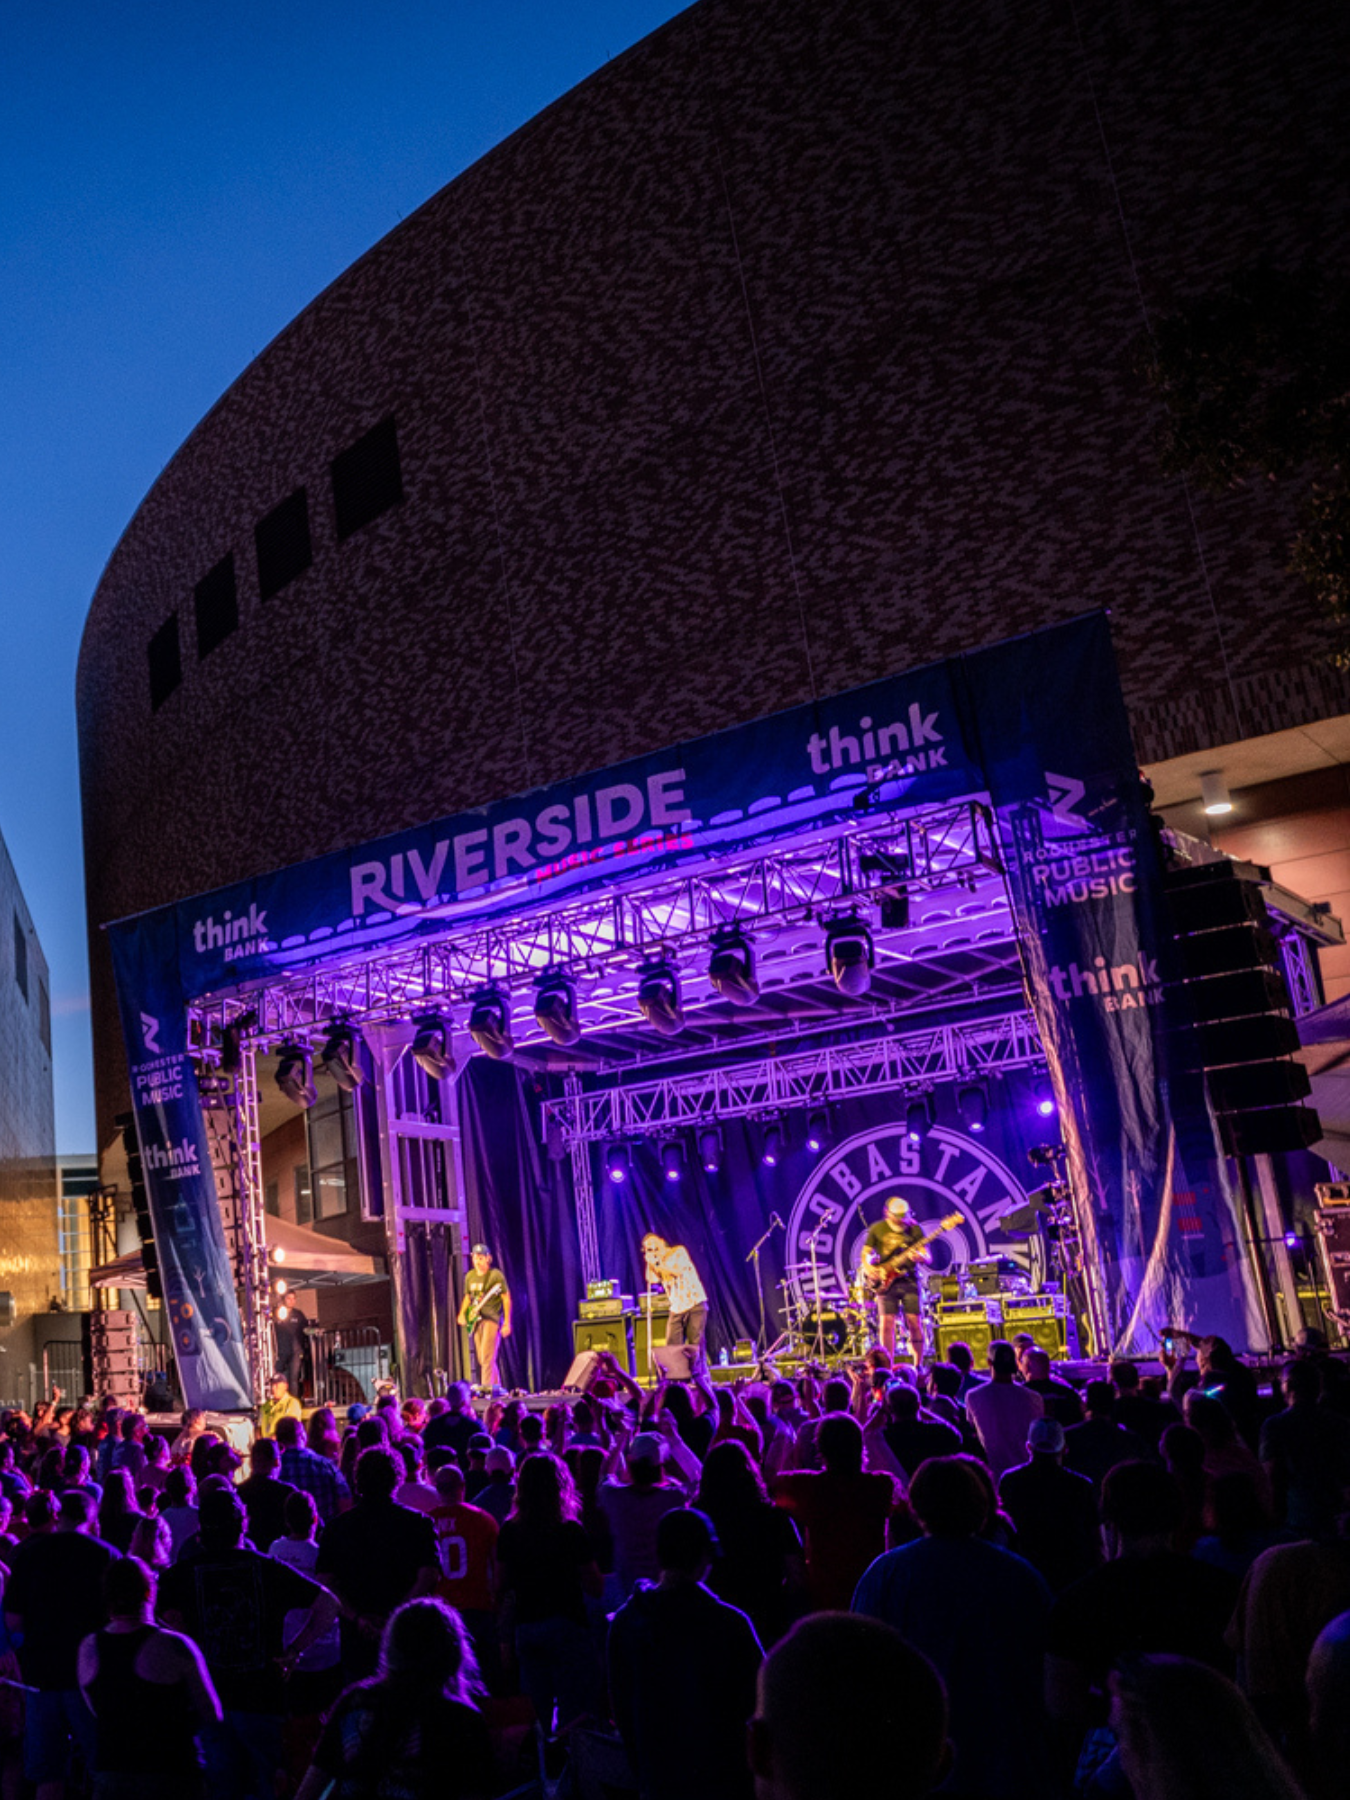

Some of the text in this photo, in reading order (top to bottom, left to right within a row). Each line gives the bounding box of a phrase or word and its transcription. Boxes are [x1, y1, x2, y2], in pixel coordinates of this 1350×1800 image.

[807, 702, 944, 775] think
[866, 746, 948, 784] BANK
[350, 768, 693, 917] RIVERSIDE
[535, 832, 695, 884] MUSIC SERIES
[1032, 846, 1137, 886] PUBLIC
[1043, 872, 1137, 908] MUSIC
[193, 903, 268, 953] think
[224, 937, 269, 962] BANK
[1049, 950, 1161, 1000] think
[136, 1065, 184, 1090] PUBLIC
[141, 1083, 184, 1106] MUSIC
[144, 1137, 198, 1170] think
[170, 1163, 201, 1179] BANK
